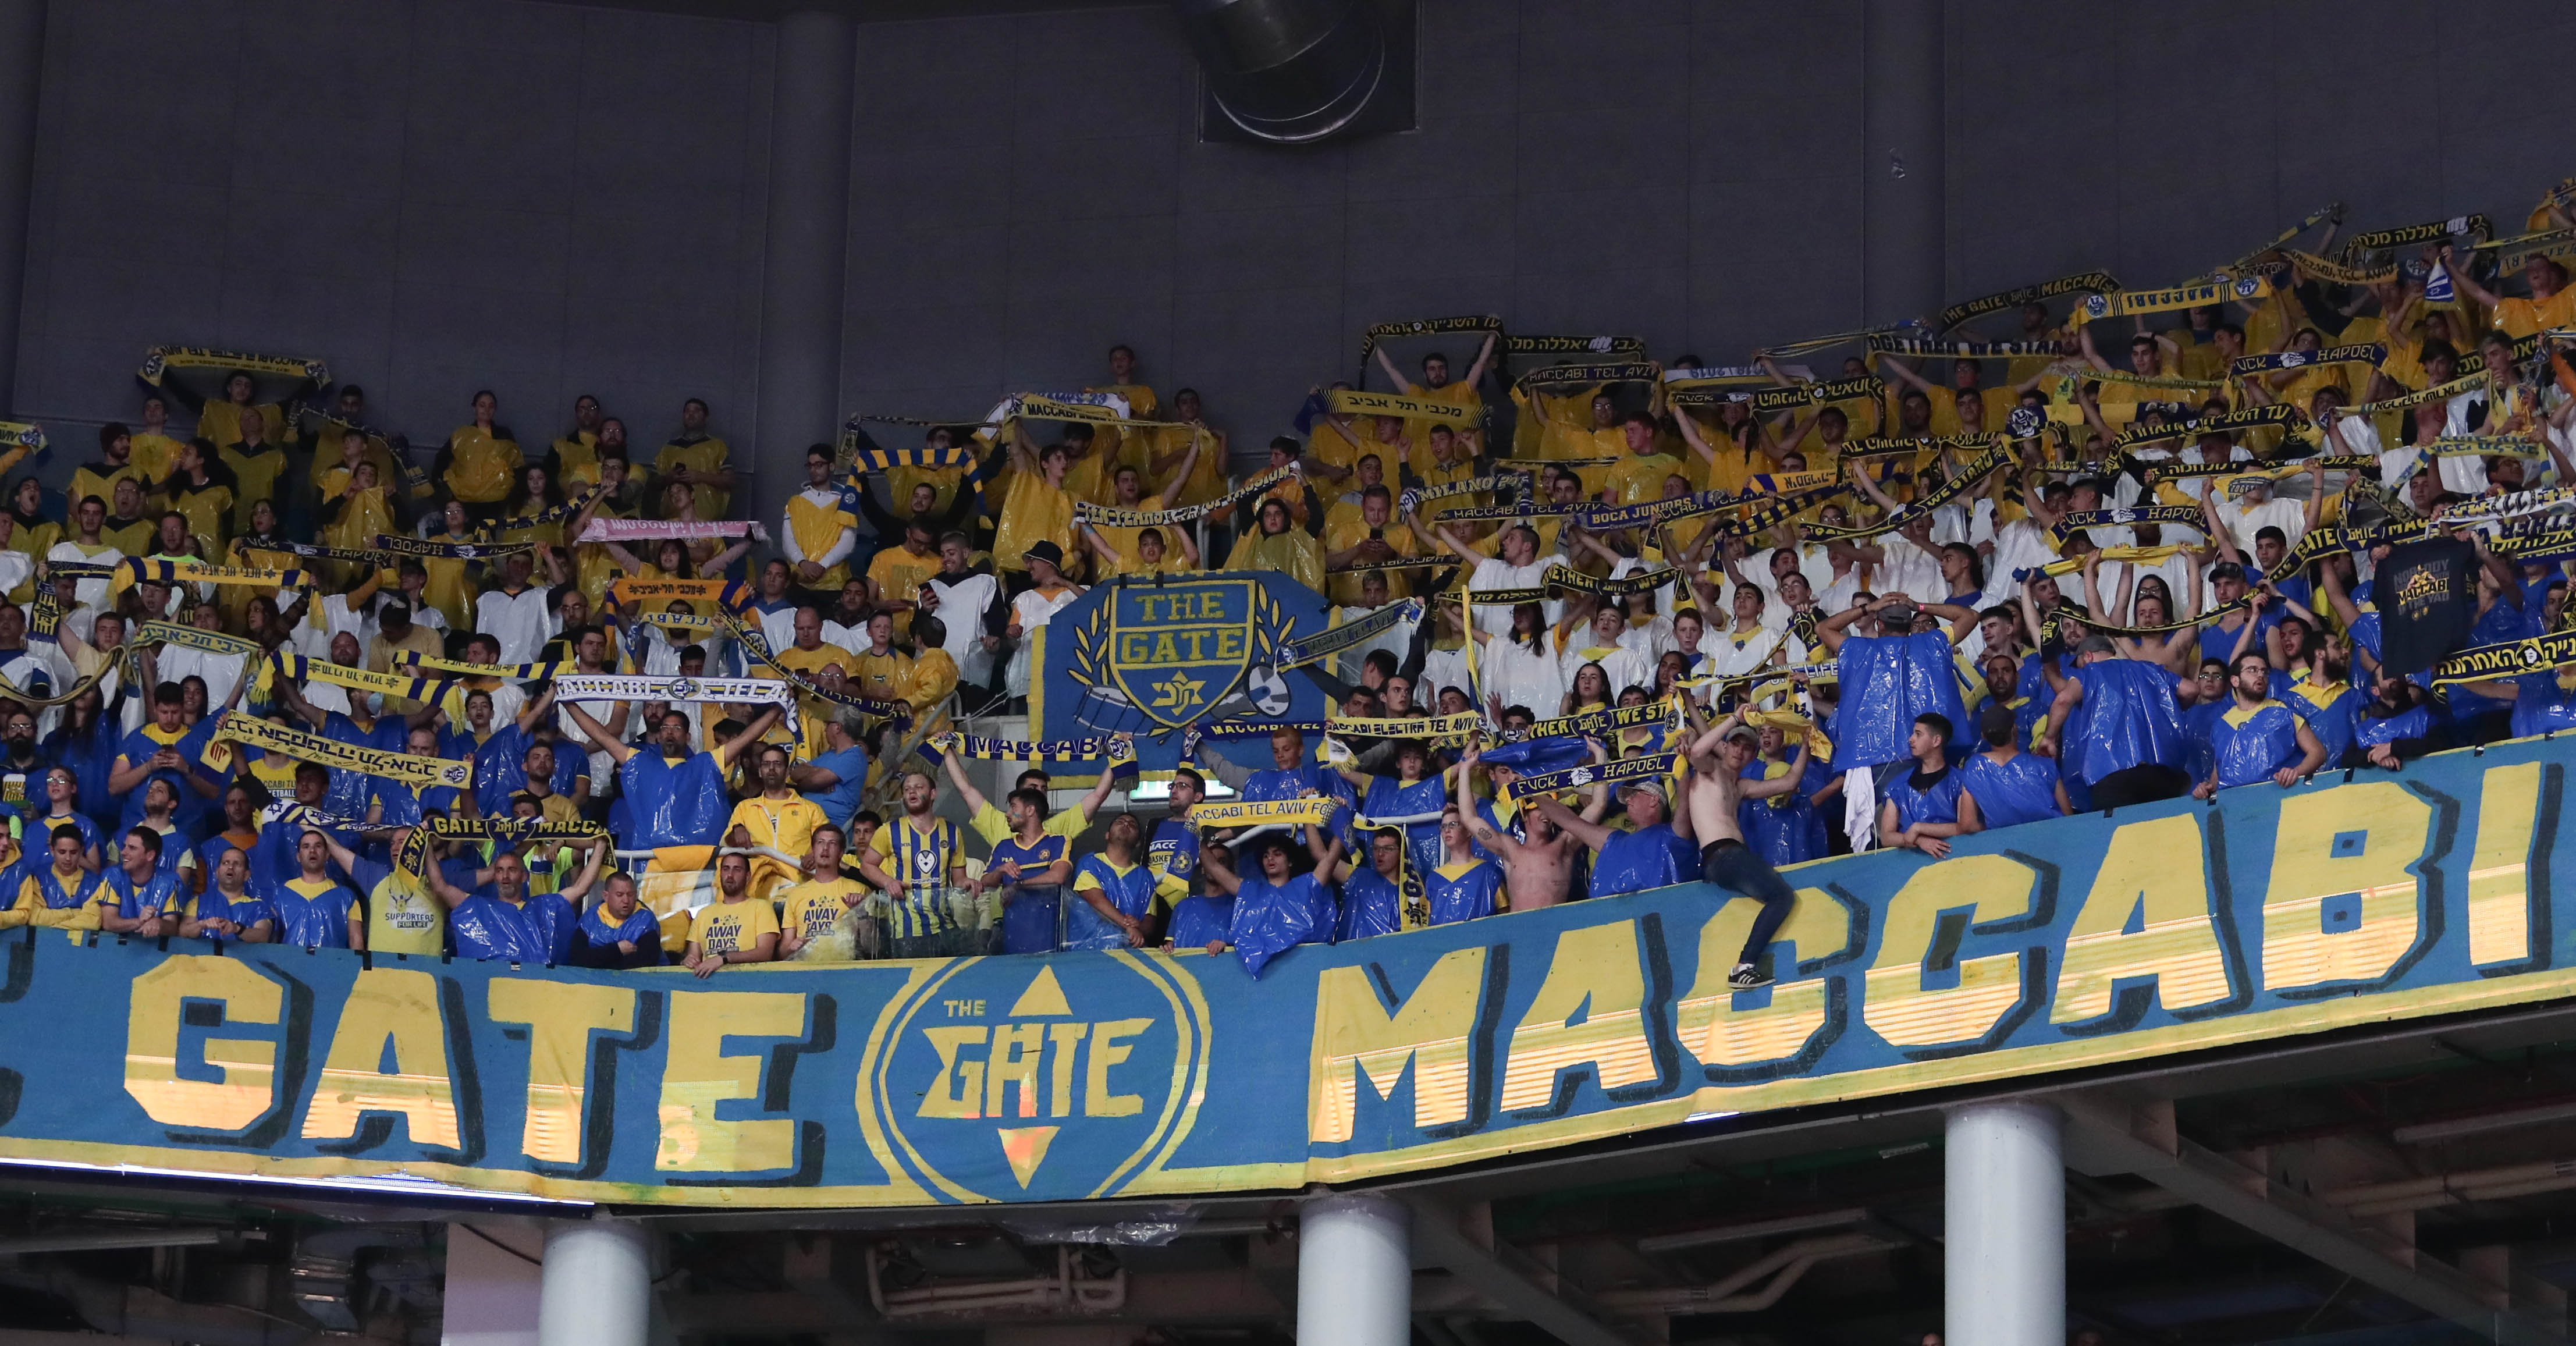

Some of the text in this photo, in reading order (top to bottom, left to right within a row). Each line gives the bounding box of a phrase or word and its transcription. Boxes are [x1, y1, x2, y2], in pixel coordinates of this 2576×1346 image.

[2394, 222, 2445, 243] יאללה
[1968, 294, 2003, 312] GATE
[1538, 336, 1588, 350] יאללה
[2236, 345, 2375, 371] UCK HAPOEL
[1529, 367, 1657, 382] MACCABI TEL AVIV
[1347, 396, 1462, 417] מכבי תל אביב
[1417, 476, 1493, 503] MILANO
[1926, 486, 1951, 507] WE
[1454, 503, 1601, 518] MACCABI TEL AVIV
[1591, 497, 1692, 525] BOCA JUNIORS
[2147, 507, 2208, 528] HAPOEL
[385, 536, 445, 556] HAPOEL
[2293, 528, 2337, 560] GATE
[1135, 591, 1224, 621] THE
[647, 614, 709, 626] CCABI
[1120, 628, 1244, 664] GATE
[1804, 662, 1838, 678] LIFE
[2439, 648, 2516, 676] האחרונה
[722, 682, 758, 698] TEL
[1329, 723, 1371, 734] ACCABI
[1429, 719, 1448, 732] TEL
[1452, 716, 1475, 731] AVIV
[1616, 706, 1641, 725] WE
[225, 718, 437, 776] כבי אלקטרה תל-אביב
[970, 734, 1109, 755] MACCABI
[1603, 757, 1666, 779] HAPOEL
[1248, 804, 1274, 815] TEL
[1276, 802, 1307, 814] AVIV
[1311, 802, 1330, 815] FC
[408, 816, 484, 853] TH GATE
[1149, 842, 1177, 851] MACC
[385, 912, 435, 922] SUPPORTERS
[804, 908, 839, 923] AWAY
[706, 924, 742, 939] AWAY
[708, 938, 736, 950] DAYS
[1307, 760, 2541, 1144] MACCABI
[944, 999, 986, 1017] THE
[123, 953, 806, 1172] GATE
[916, 1018, 1155, 1118] GATE
